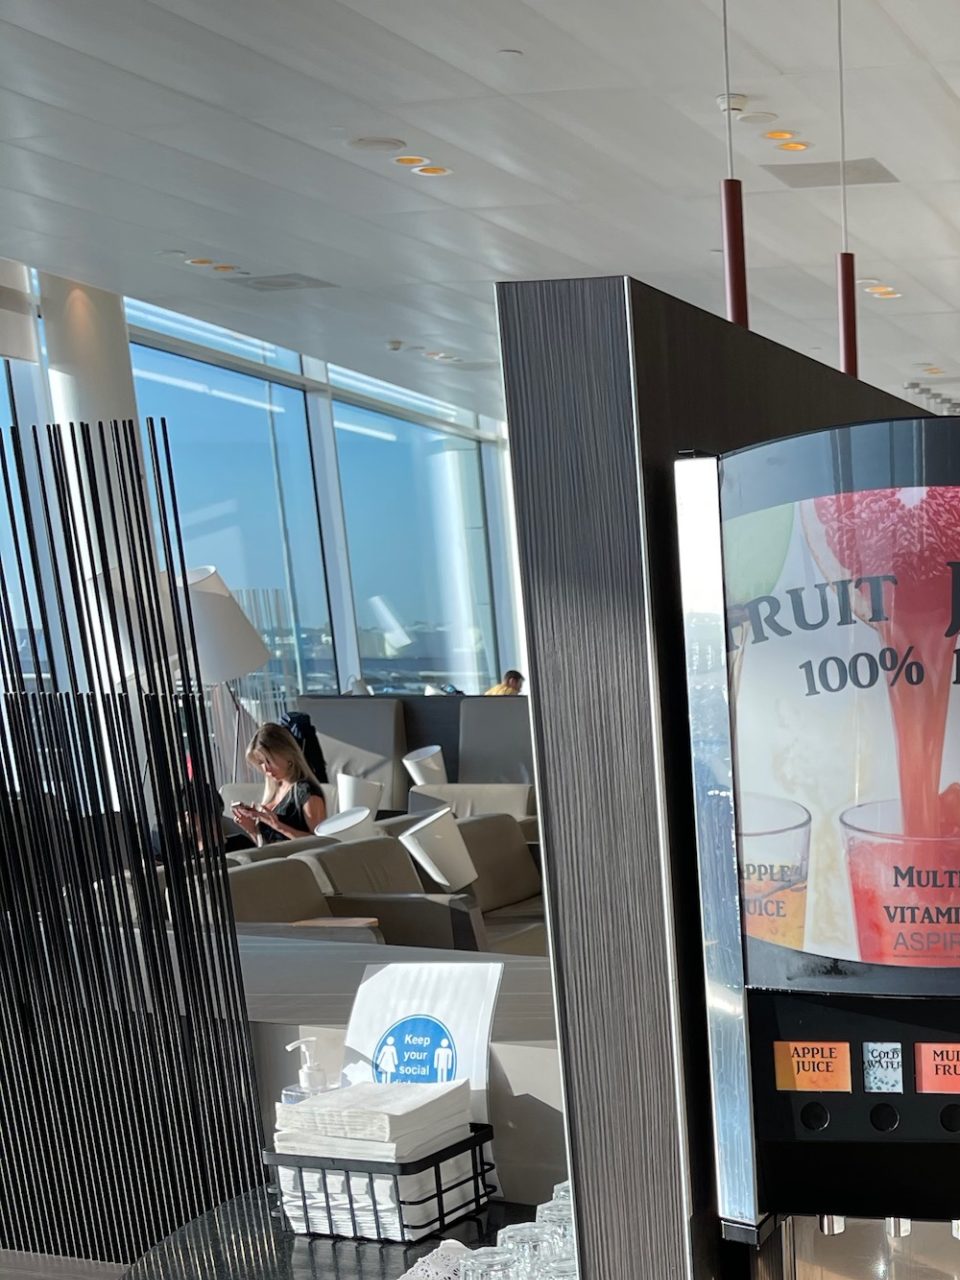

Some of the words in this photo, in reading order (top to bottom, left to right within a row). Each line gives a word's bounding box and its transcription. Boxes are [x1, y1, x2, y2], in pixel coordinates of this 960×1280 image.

[798, 646, 925, 696] 100%
[744, 863, 792, 882] PPLE
[745, 898, 787, 917] UICE
[404, 1034, 431, 1047] Keep
[403, 1051, 428, 1062] your
[791, 1046, 837, 1059] APPLE
[871, 1048, 900, 1060] COLD
[399, 1065, 430, 1076] social
[796, 1060, 834, 1075] JUICE
